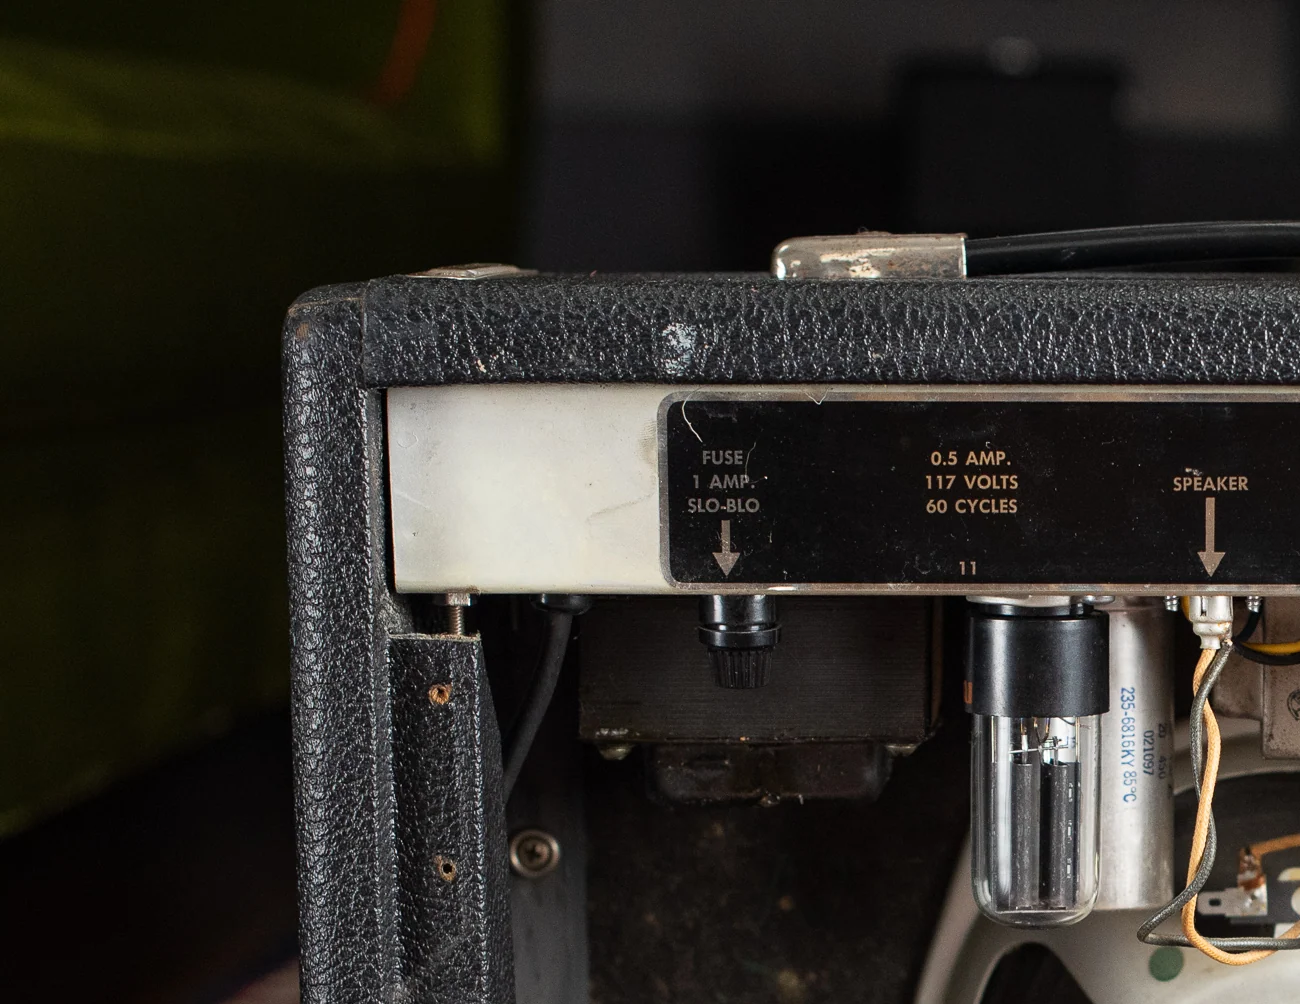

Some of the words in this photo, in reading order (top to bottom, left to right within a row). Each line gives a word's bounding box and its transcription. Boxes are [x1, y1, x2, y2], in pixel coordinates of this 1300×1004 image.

[702, 450, 743, 465] FUSE
[930, 451, 958, 466] 0.5
[965, 451, 1011, 466] AMP.
[692, 474, 699, 489] 1
[709, 474, 755, 489] AMP.
[925, 475, 954, 490] 117
[964, 475, 1019, 490] VOLTS
[1173, 476, 1249, 492] SPEAKER
[687, 498, 760, 513] SLO-BLO
[926, 499, 949, 514] 60
[954, 499, 1018, 514] CYCLES
[959, 561, 976, 576] 11
[1120, 686, 1136, 767] 235-6816KY
[1143, 730, 1154, 776] 021097
[1122, 770, 1137, 803] 85°C
